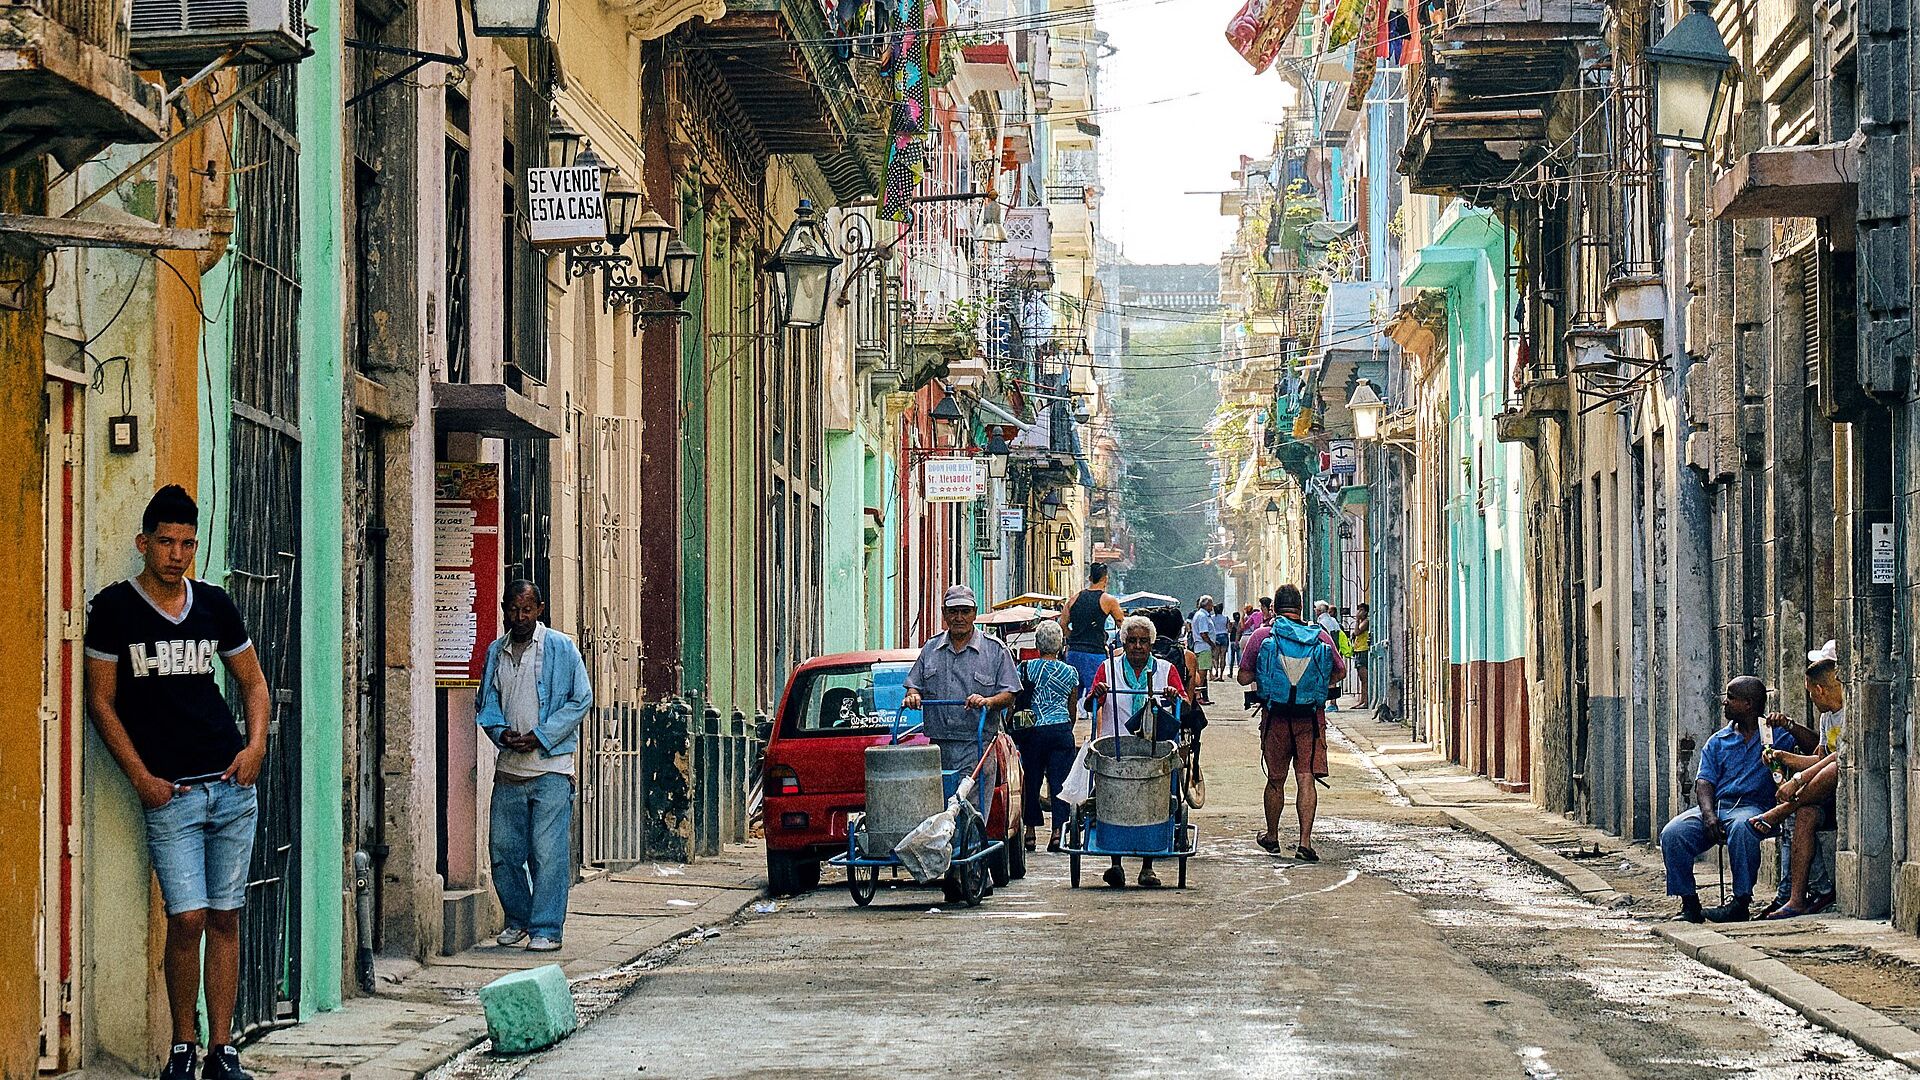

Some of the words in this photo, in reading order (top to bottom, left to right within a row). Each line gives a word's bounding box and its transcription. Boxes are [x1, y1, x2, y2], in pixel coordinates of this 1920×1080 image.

[530, 170, 546, 193] SE
[550, 169, 600, 192] VENDE
[531, 197, 566, 221] ESTA
[568, 196, 603, 219] CASA
[928, 464, 944, 472] ROOM
[959, 463, 972, 471] RENT
[939, 474, 972, 483] Alexander
